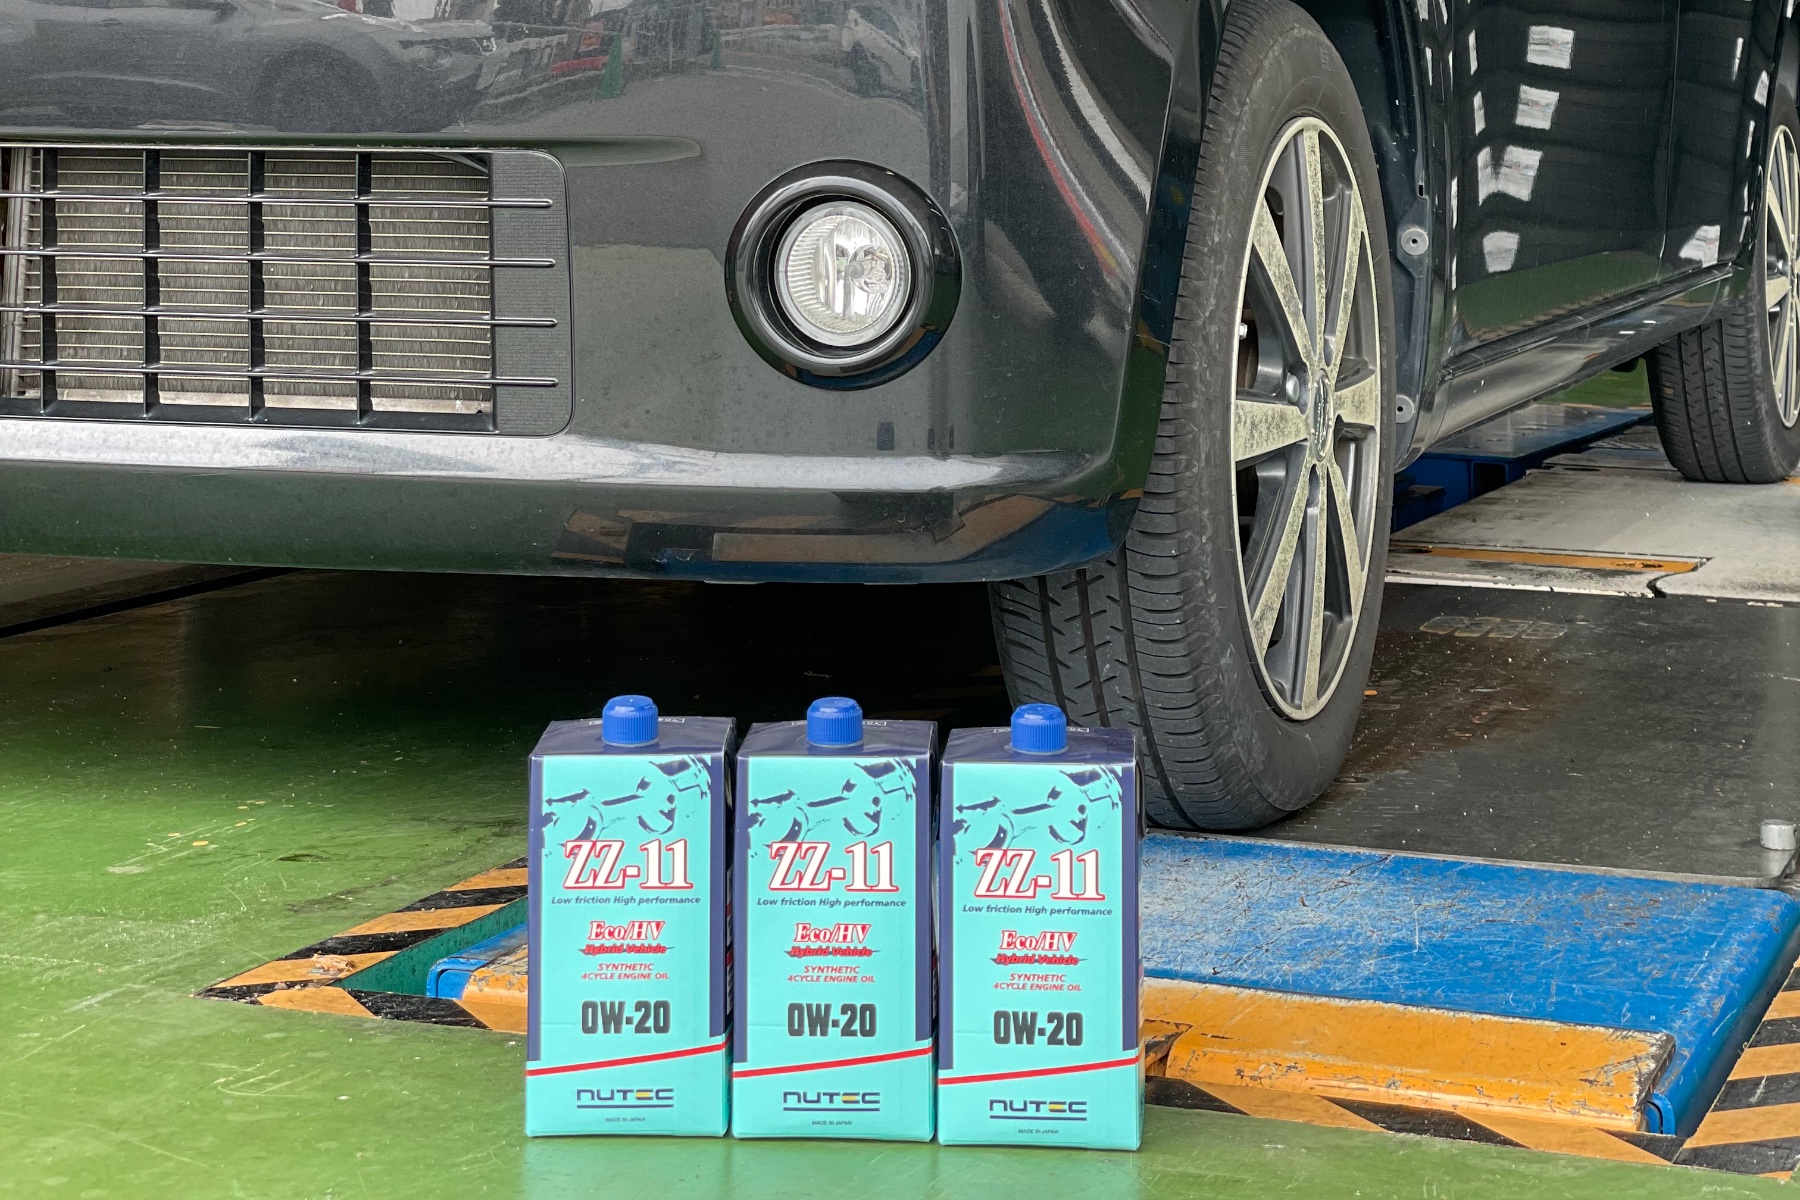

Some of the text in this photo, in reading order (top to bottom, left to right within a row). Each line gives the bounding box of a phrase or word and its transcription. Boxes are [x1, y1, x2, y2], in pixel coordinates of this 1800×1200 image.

[562, 838, 694, 890] ZZ-11
[768, 841, 900, 892] ZZ-11
[974, 848, 1106, 900] ZZ-11
[552, 896, 701, 906] Low friction High performance
[757, 898, 906, 908] Low friction High performance
[986, 905, 1022, 913] friction
[1025, 905, 1047, 915] High
[1050, 907, 1113, 916] performance
[588, 920, 666, 940] Eco/HV
[794, 922, 871, 943] Eco/HV
[1000, 930, 1078, 951] Eco/HV
[584, 944, 667, 956] Hybrid Vehicle
[790, 946, 873, 958] Hybrid Vehicle
[996, 953, 1079, 966] Hybrid Vehicle
[598, 963, 654, 972] SYNTHETIC
[804, 966, 860, 974] SYNTHETIC
[1010, 973, 1066, 982] SYNTHETIC
[1030, 983, 1064, 991] ENGINE
[582, 1000, 671, 1034] 0W-20
[788, 1002, 876, 1037] 0W-20
[994, 1010, 1083, 1046] 0W-20
[576, 1089, 674, 1100] NUTEC
[783, 1092, 880, 1104] NUTEC
[989, 1099, 1087, 1113] NUTEC
